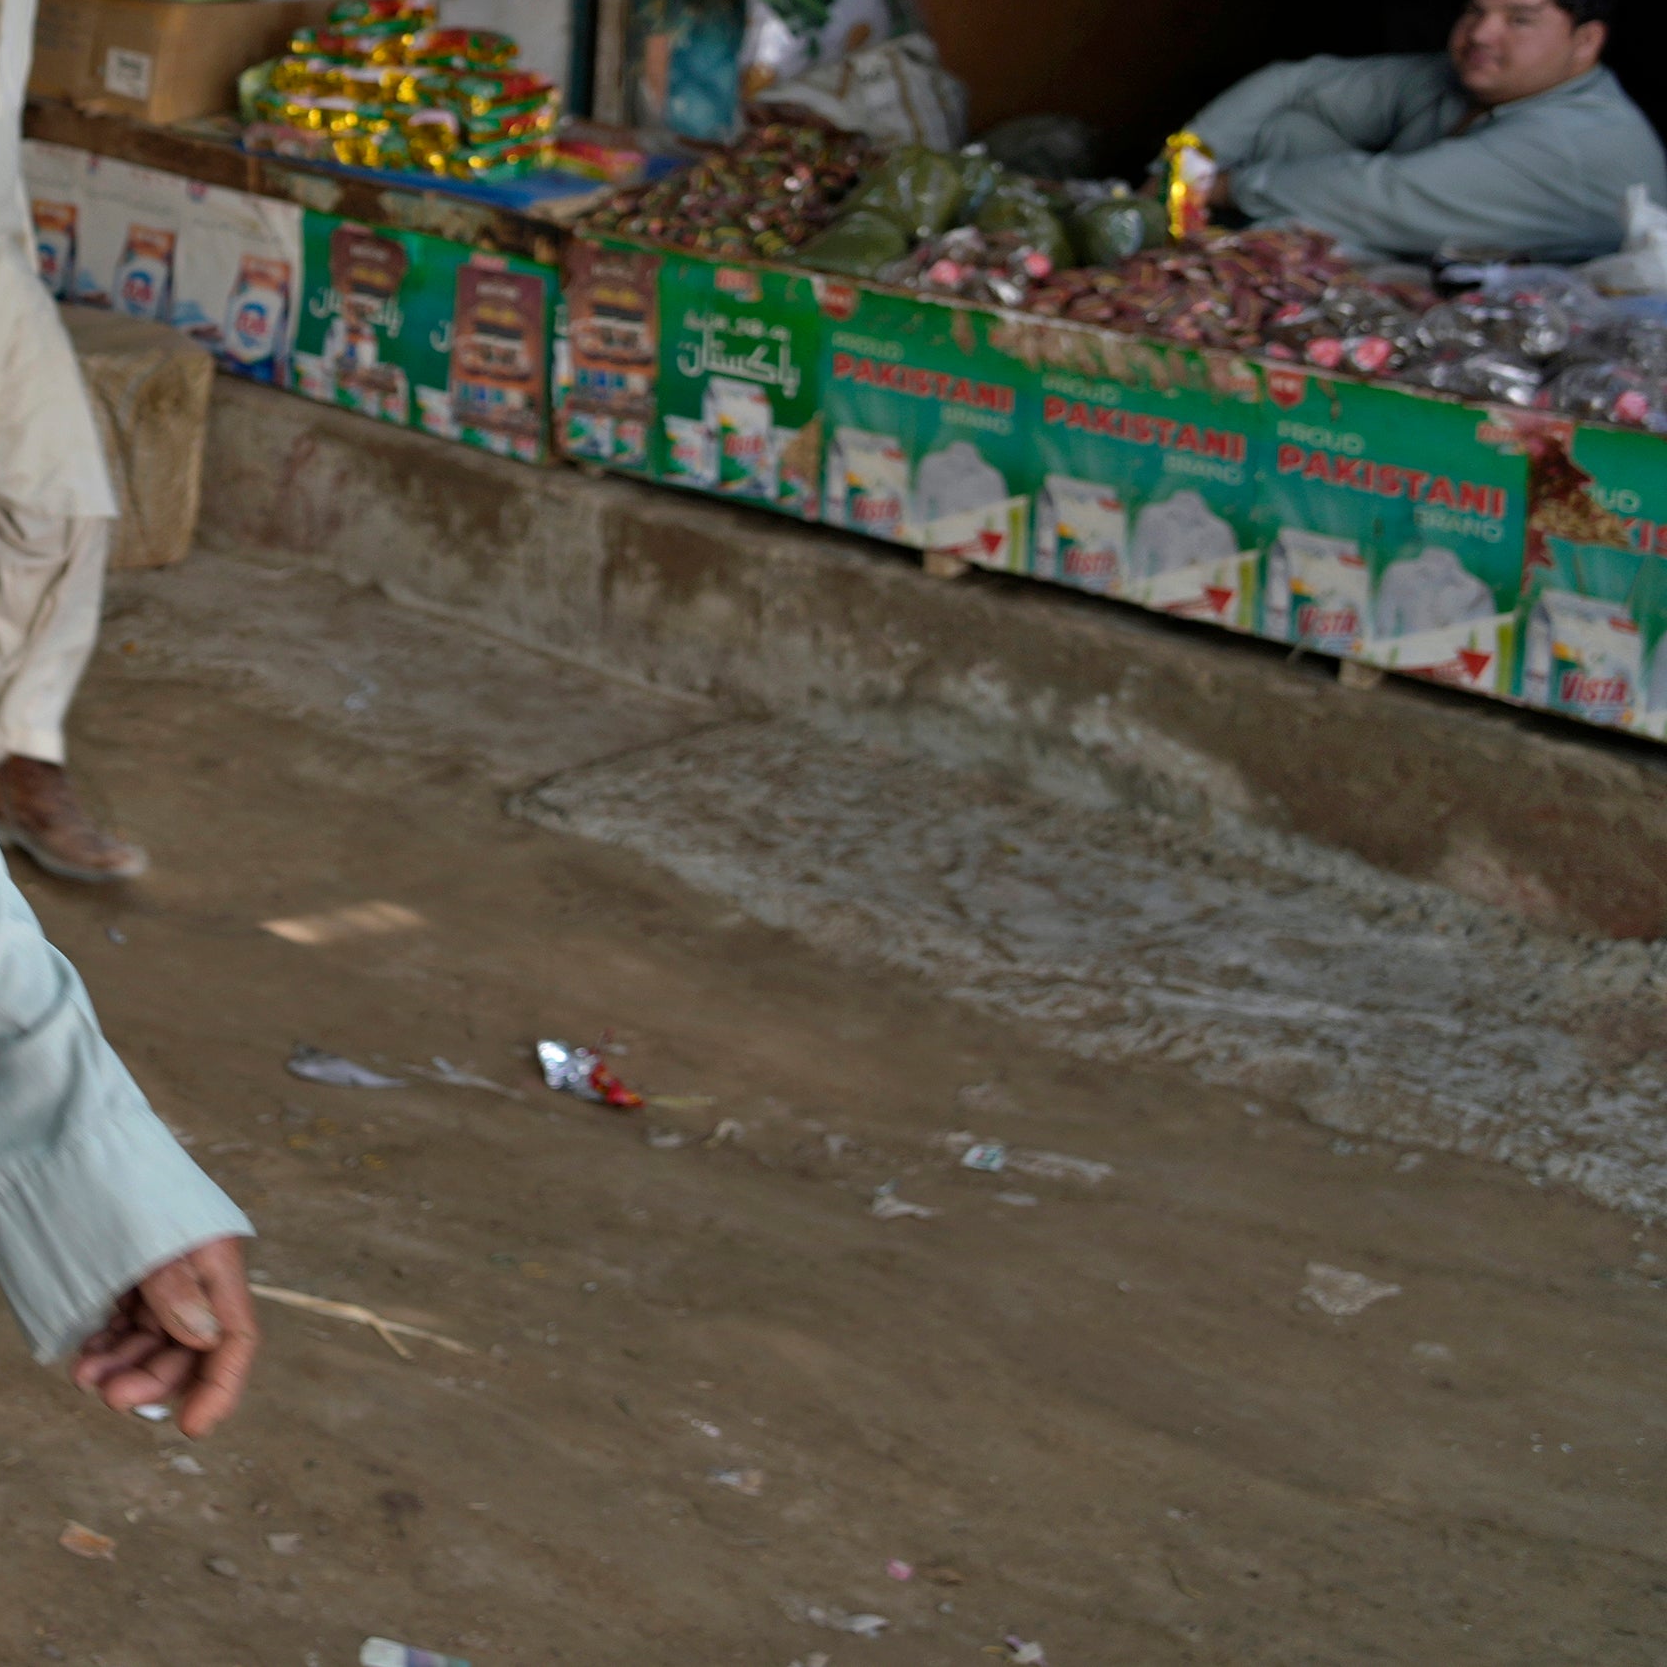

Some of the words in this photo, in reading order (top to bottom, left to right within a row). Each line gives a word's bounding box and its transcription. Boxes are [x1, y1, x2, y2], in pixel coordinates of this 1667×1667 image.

[675, 337, 802, 400] پاکستان
[831, 352, 1017, 415] PAKISTANI
[1042, 394, 1247, 465] PAKISTANI
[1275, 443, 1509, 521] PAKISTANI
